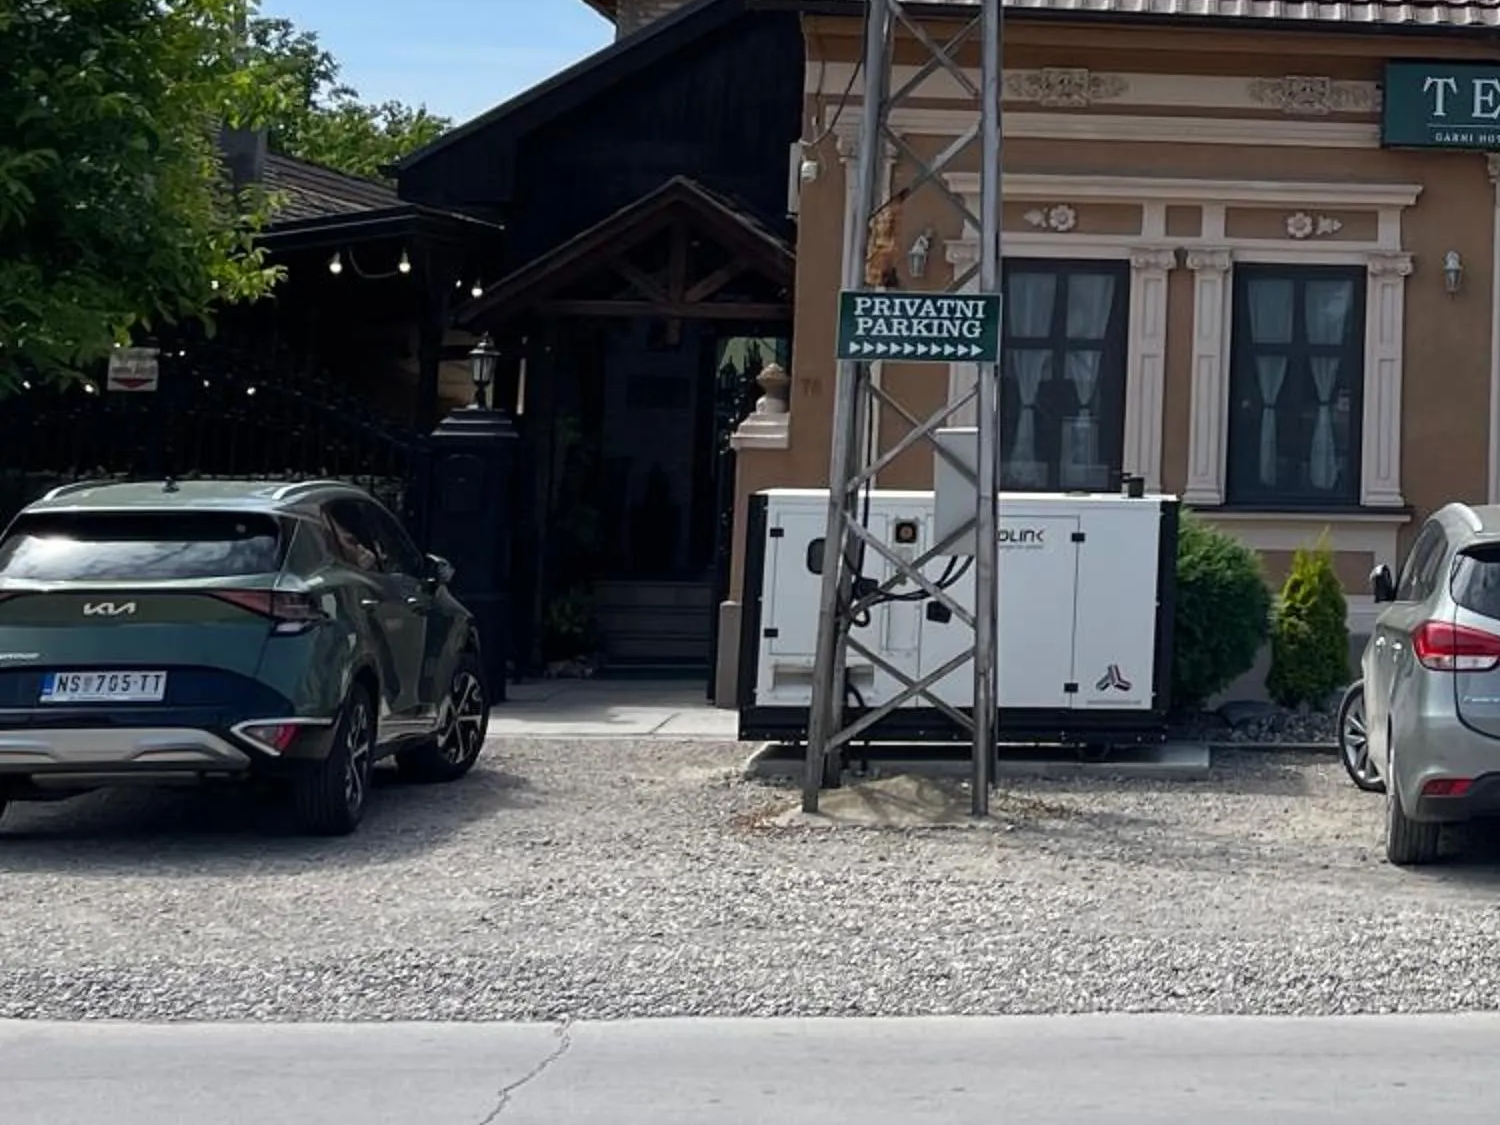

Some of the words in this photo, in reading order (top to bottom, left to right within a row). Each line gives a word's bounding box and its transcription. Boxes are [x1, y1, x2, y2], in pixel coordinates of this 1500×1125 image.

[1435, 132, 1474, 142] GARNI
[853, 296, 987, 319] PRIVATNI
[855, 317, 983, 338] PARKING
